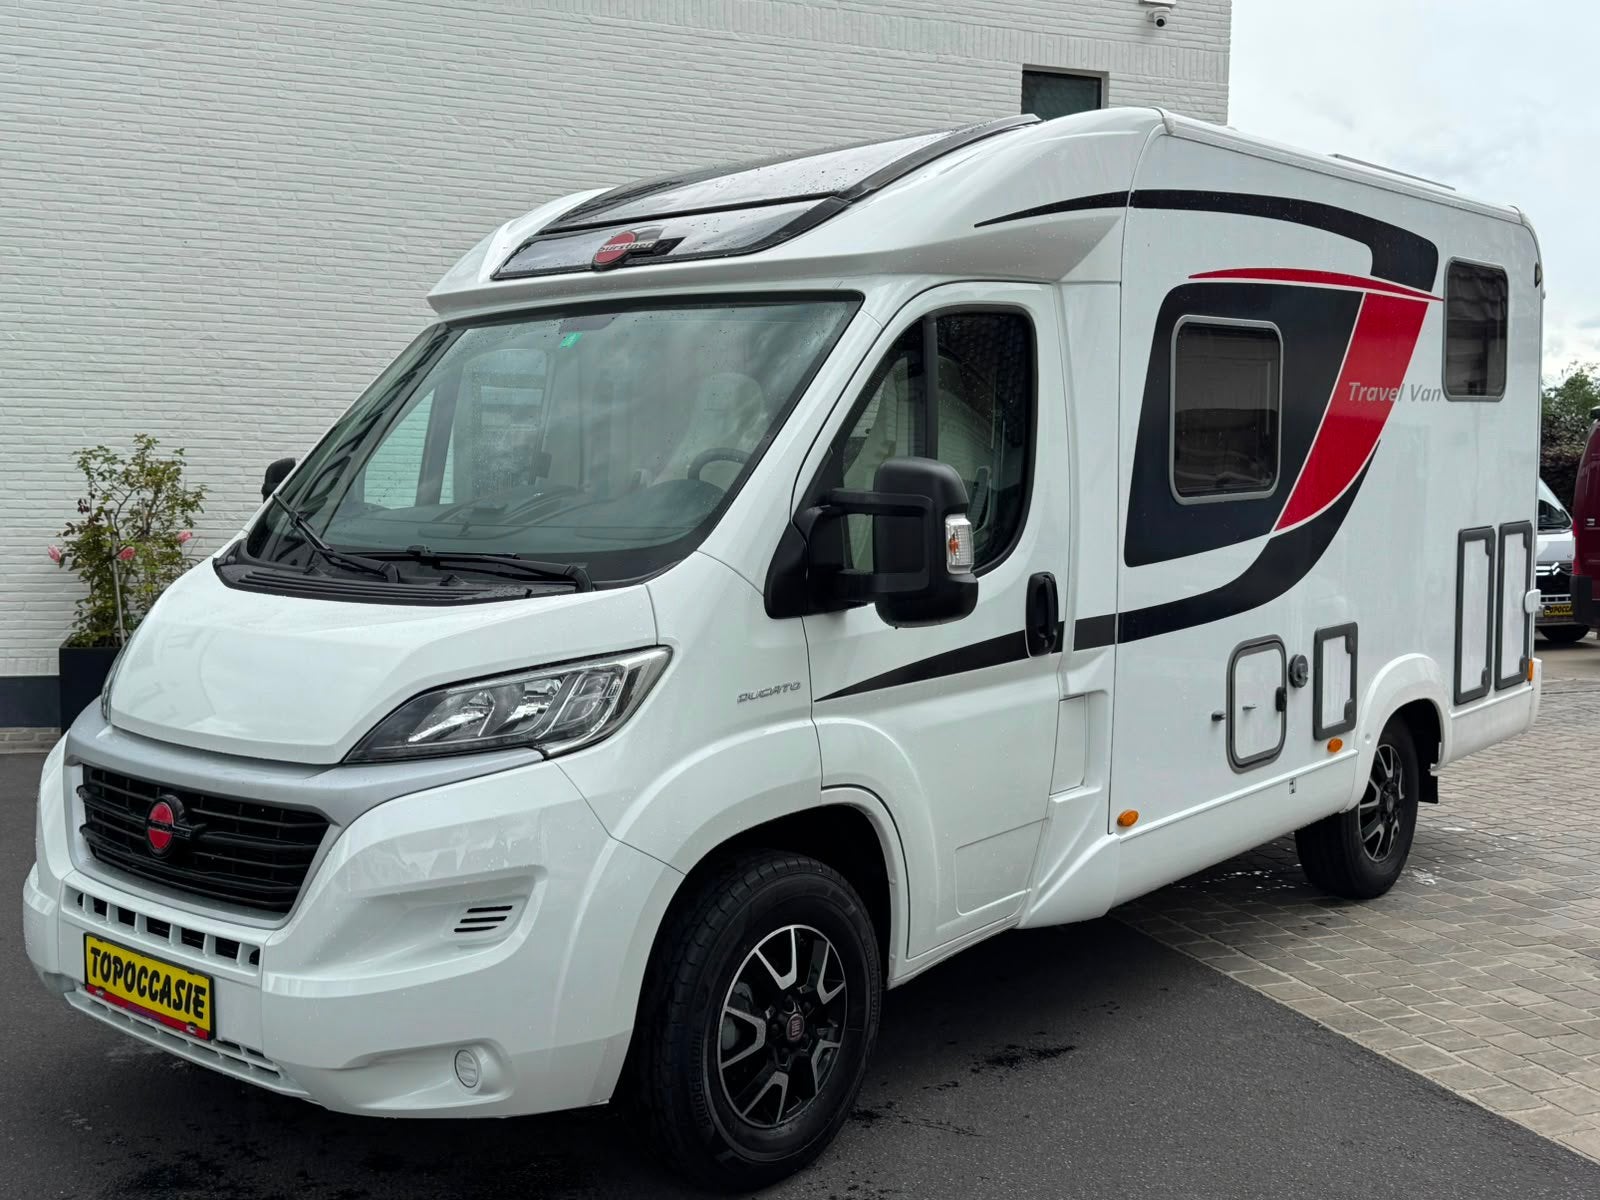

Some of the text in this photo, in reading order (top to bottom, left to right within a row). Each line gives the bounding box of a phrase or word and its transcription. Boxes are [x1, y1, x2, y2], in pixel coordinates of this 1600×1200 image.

[1349, 382, 1441, 402] Travel Van
[737, 681, 801, 703] DUCATO
[90, 946, 207, 1020] TOPOCCASIE
